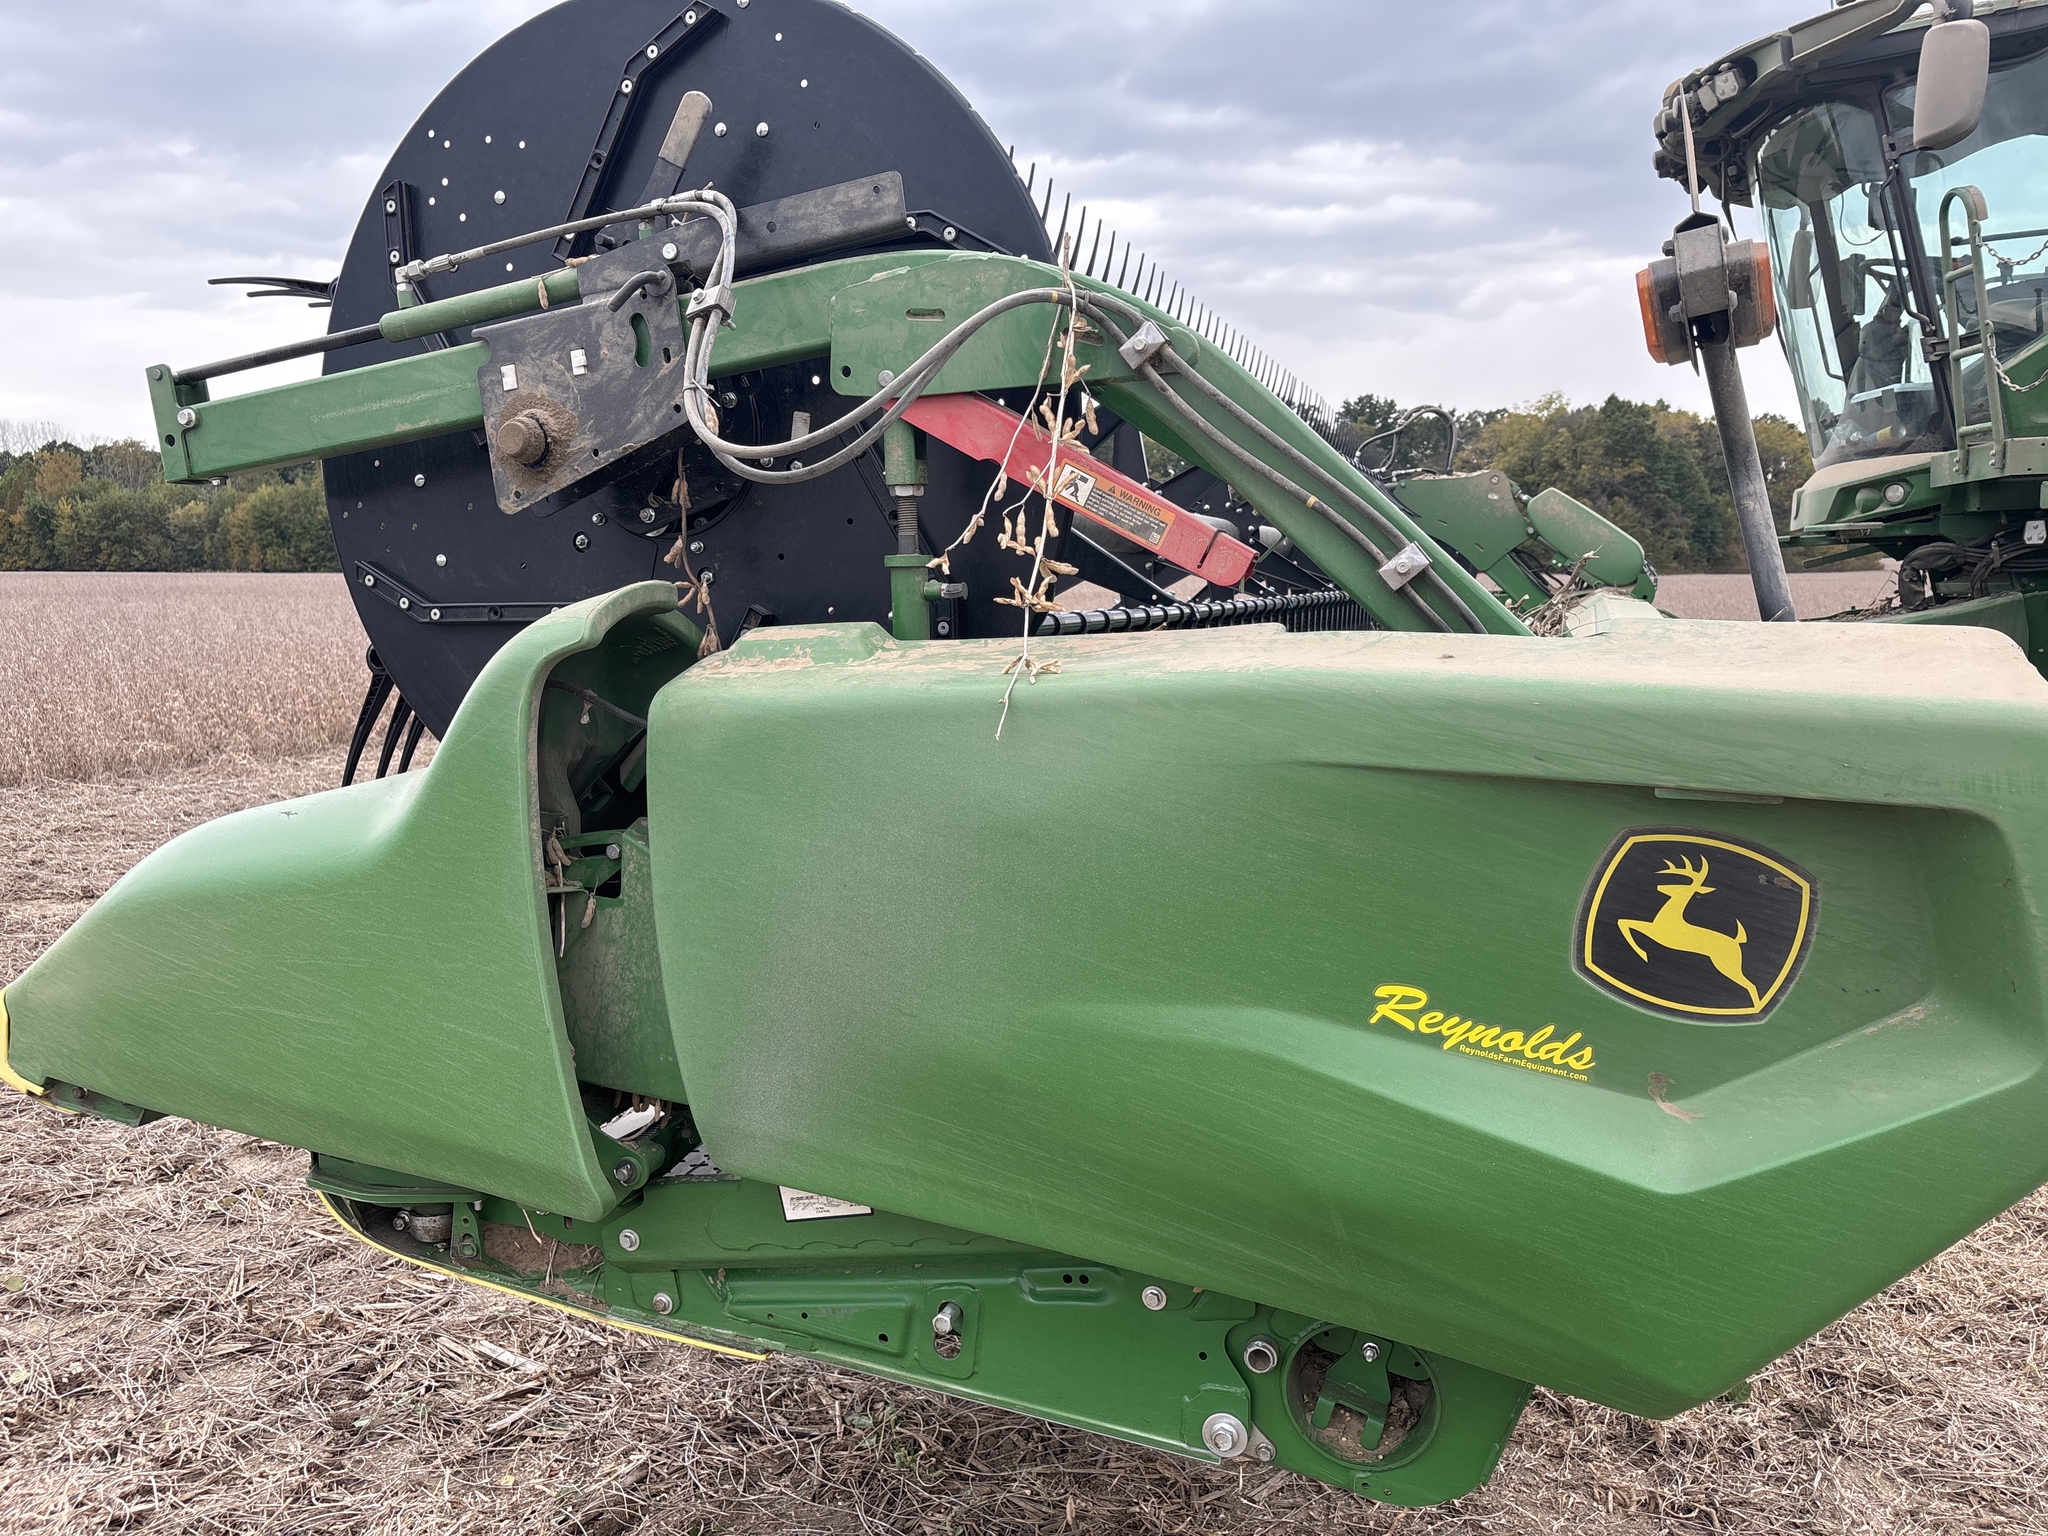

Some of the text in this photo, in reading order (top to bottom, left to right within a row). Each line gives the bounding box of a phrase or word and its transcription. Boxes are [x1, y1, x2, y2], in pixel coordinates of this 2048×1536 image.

[1120, 489, 1162, 517] WARNING
[1369, 985, 1596, 1070] Reynolds
[1459, 1045, 1588, 1082] ReynoldsFarmEquipment.com
